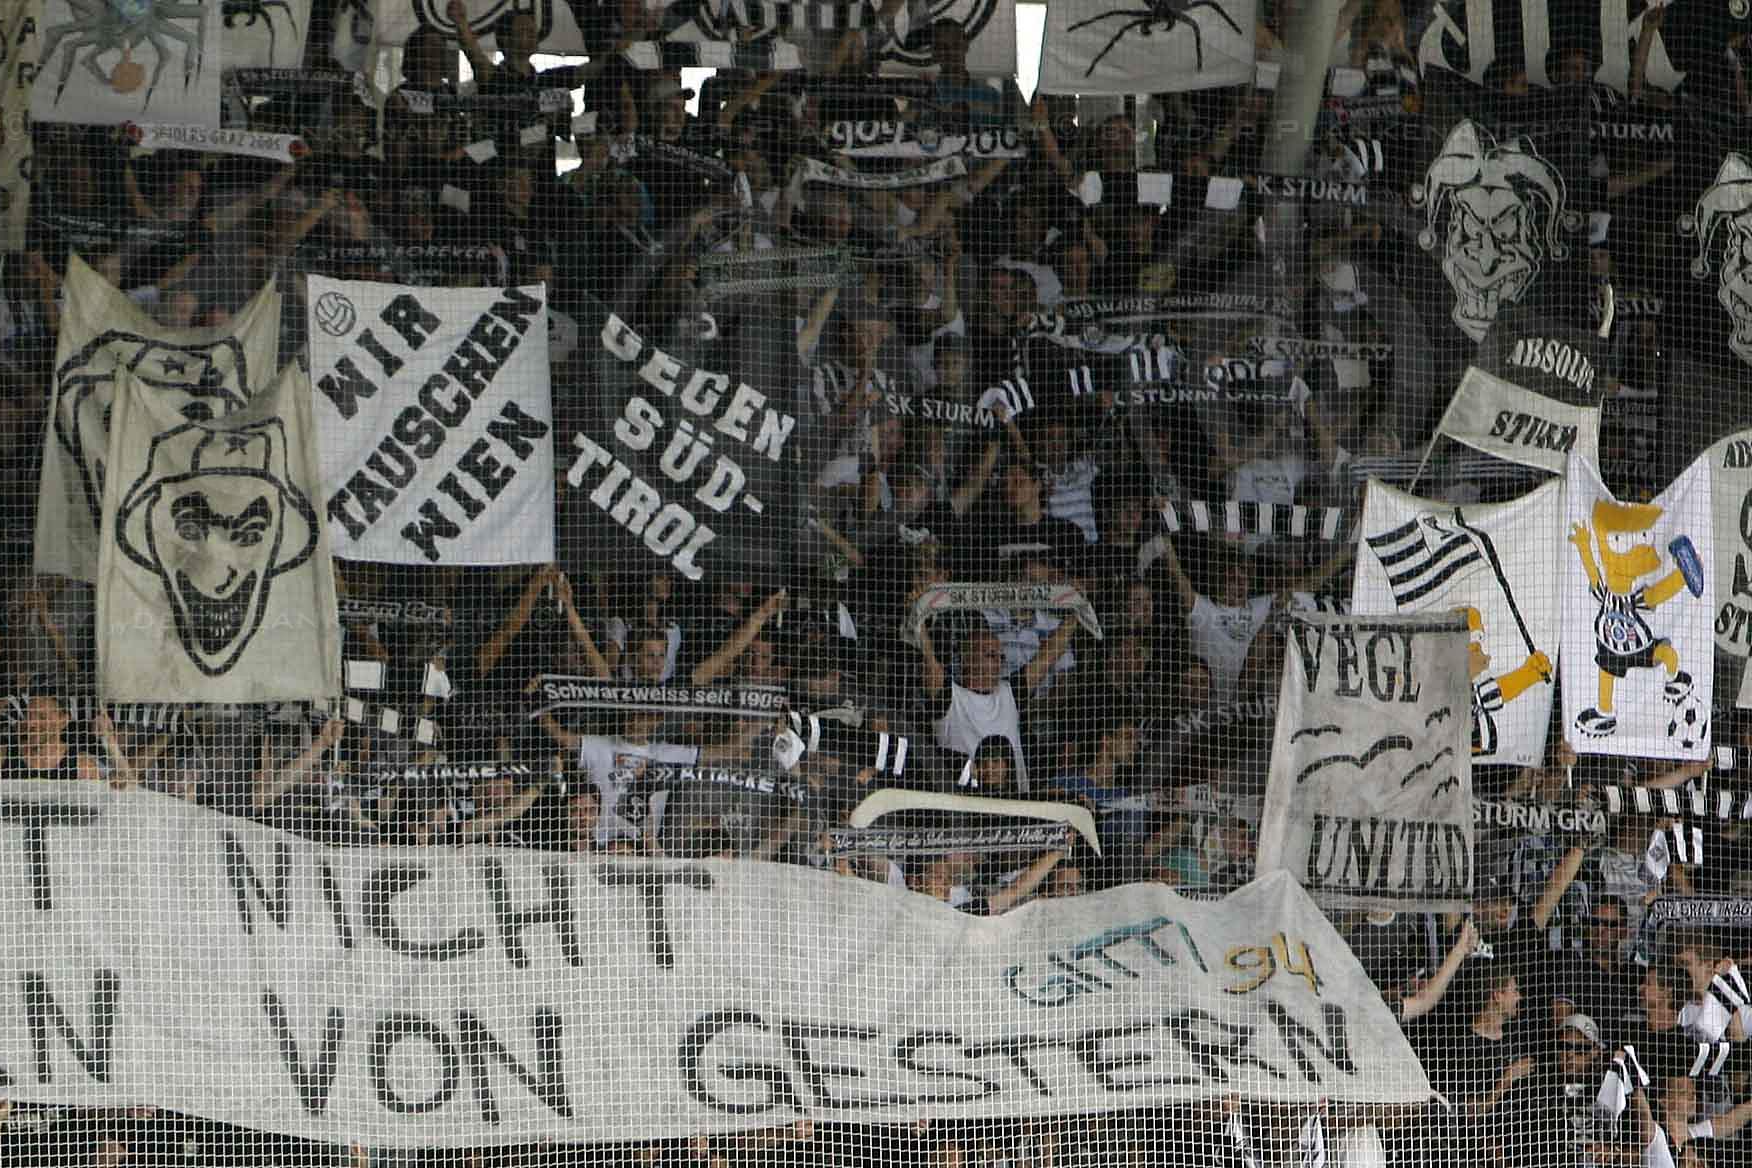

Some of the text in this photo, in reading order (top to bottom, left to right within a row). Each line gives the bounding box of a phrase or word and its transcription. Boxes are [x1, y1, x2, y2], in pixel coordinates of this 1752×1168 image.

[317, 294, 443, 421] WIR
[327, 285, 543, 541] TAUSCHEN
[601, 312, 796, 462] GEGEN
[921, 397, 996, 430] STURM
[400, 400, 550, 562] WIEN
[566, 431, 717, 582] TIROL
[613, 395, 764, 514] SÜD-
[544, 682, 692, 704] Schwarzweiss
[696, 686, 732, 704] seit
[223, 828, 715, 970] NICHT
[1221, 932, 1326, 996] 94
[261, 989, 576, 1126] VON
[678, 1001, 1359, 1112] GESTERN
